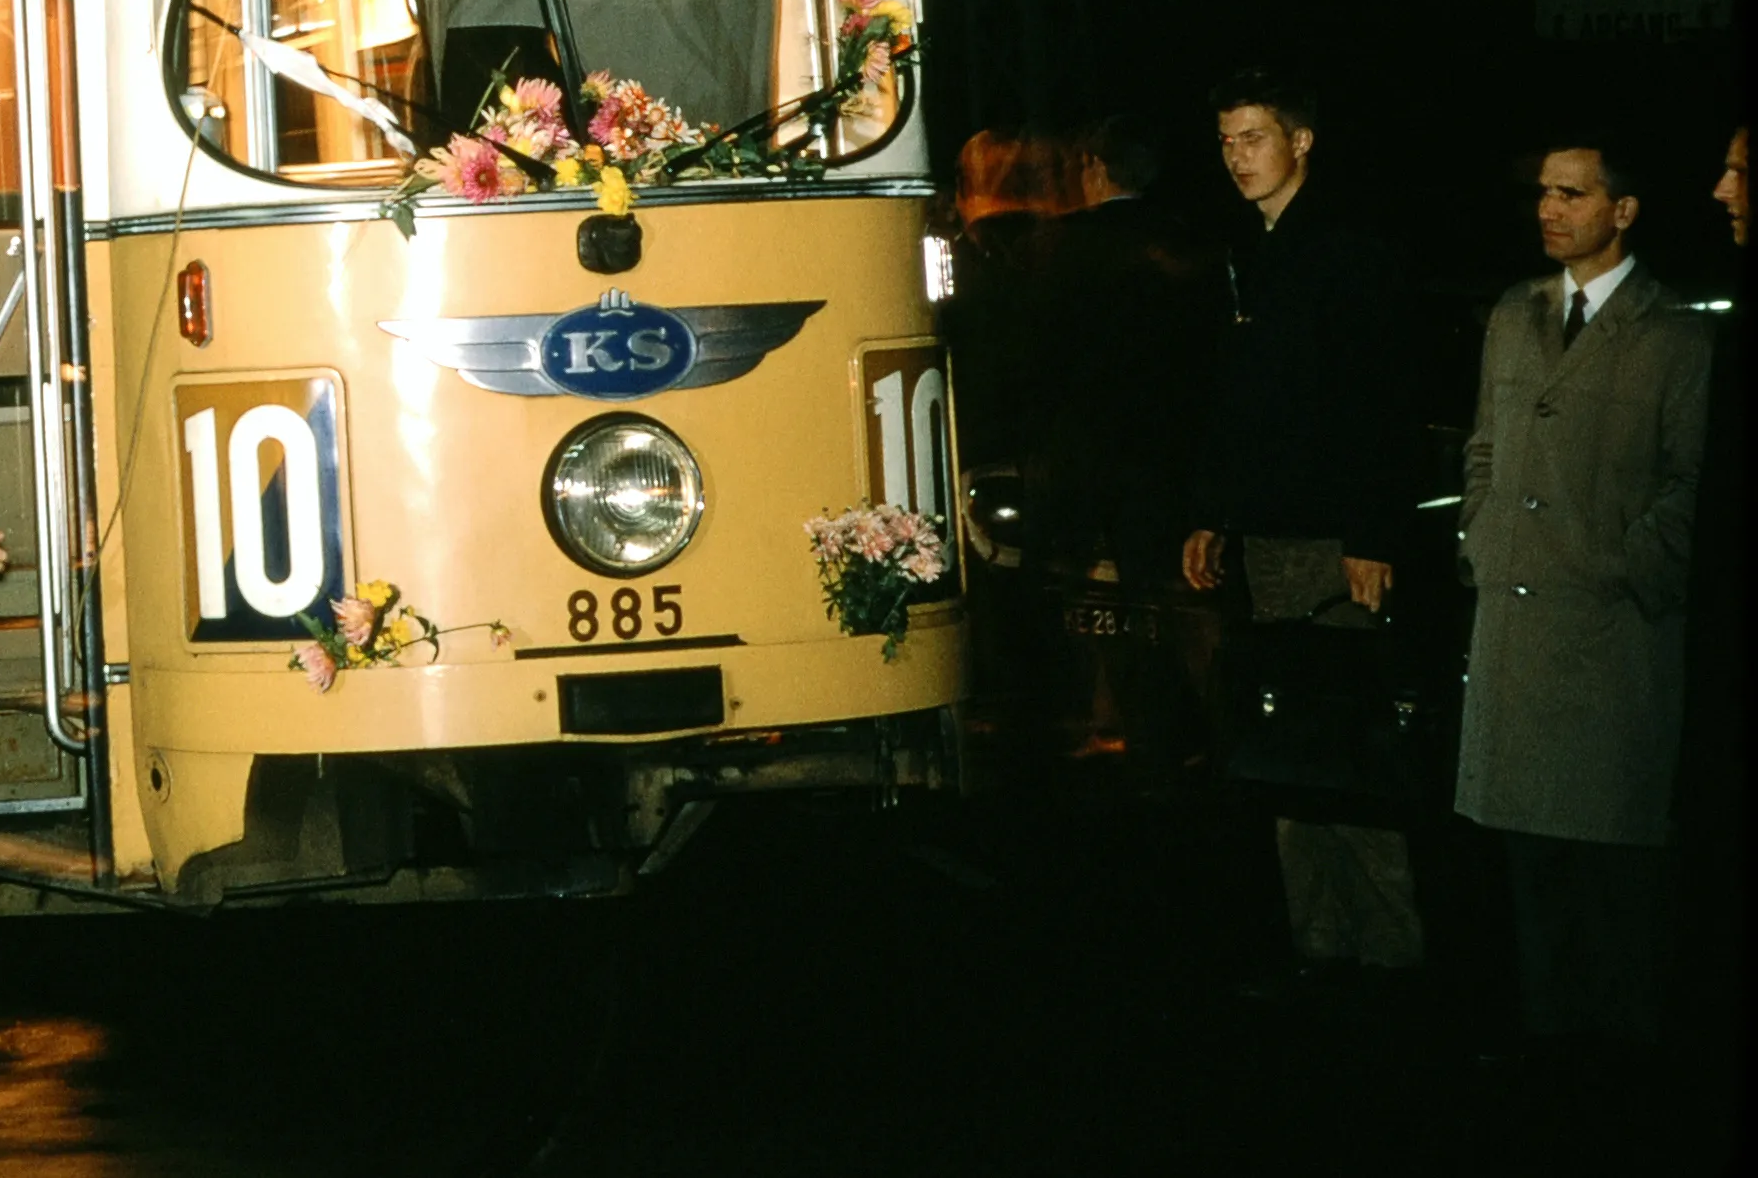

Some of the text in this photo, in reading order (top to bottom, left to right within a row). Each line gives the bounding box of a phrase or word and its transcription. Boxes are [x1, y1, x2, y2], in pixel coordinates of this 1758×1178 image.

[563, 326, 670, 375] KS
[184, 403, 325, 621] 10
[873, 368, 953, 572] 10
[567, 584, 684, 642] 885
